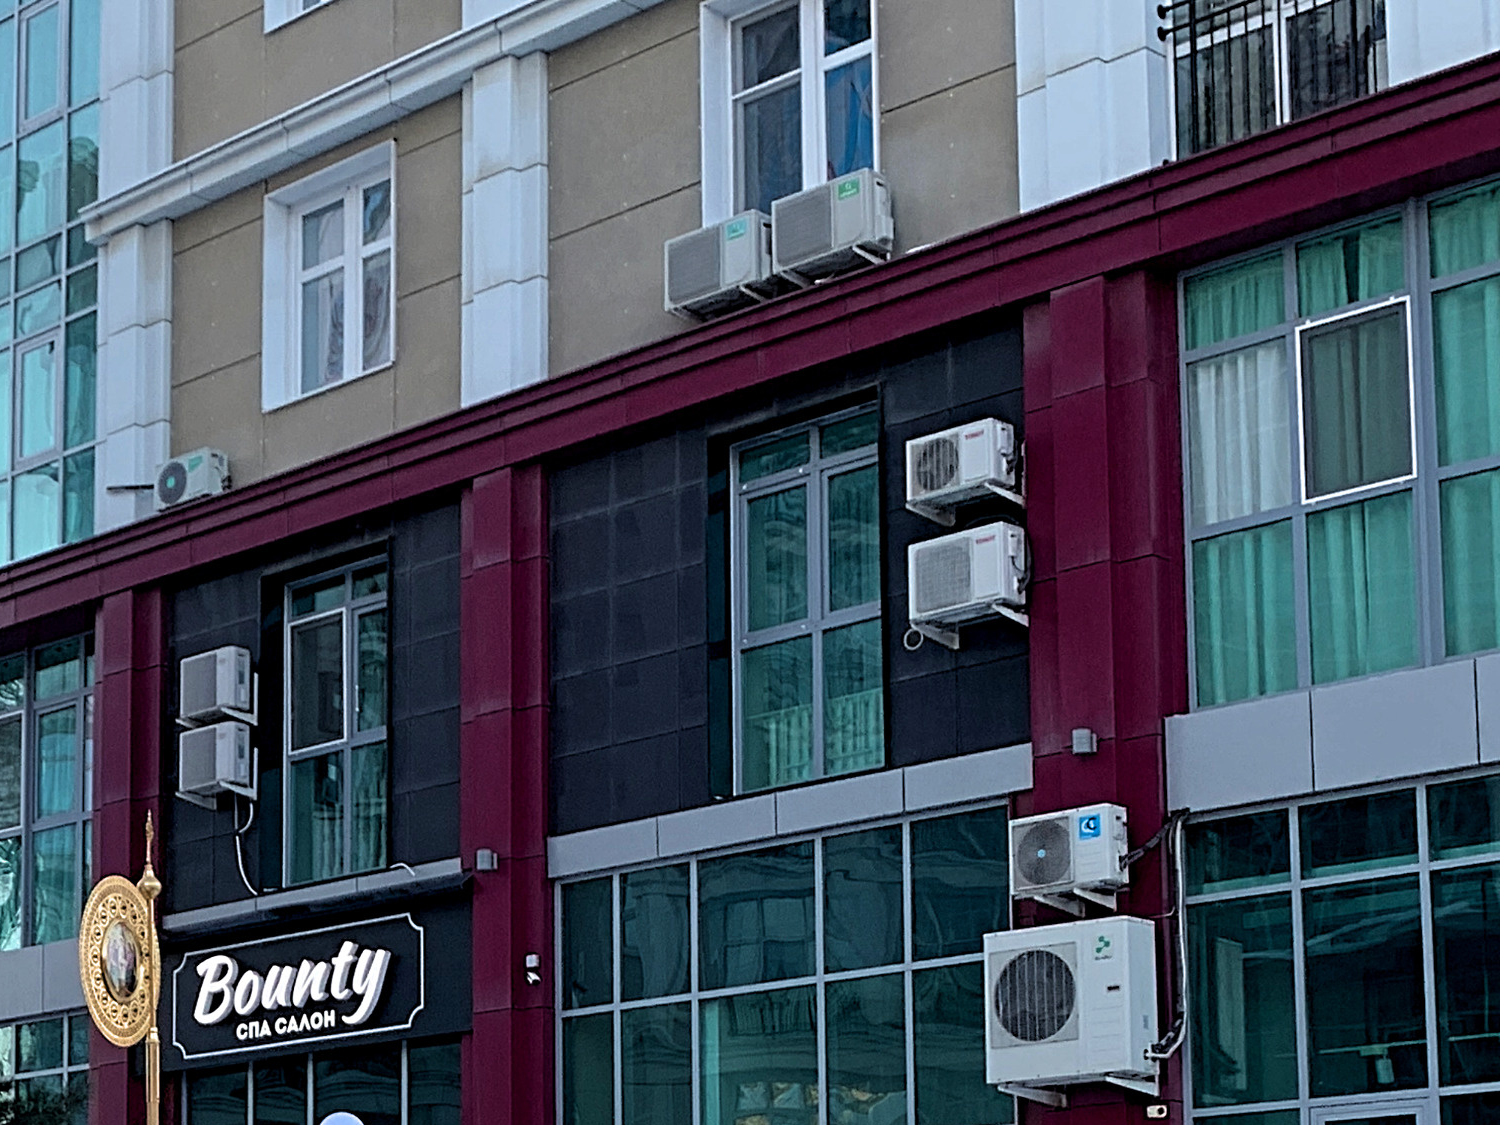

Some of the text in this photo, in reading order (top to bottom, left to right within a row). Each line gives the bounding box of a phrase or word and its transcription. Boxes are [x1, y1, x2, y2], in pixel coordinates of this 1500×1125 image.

[194, 941, 391, 1025] Bounty
[236, 1010, 336, 1041] СПА САЛОН
